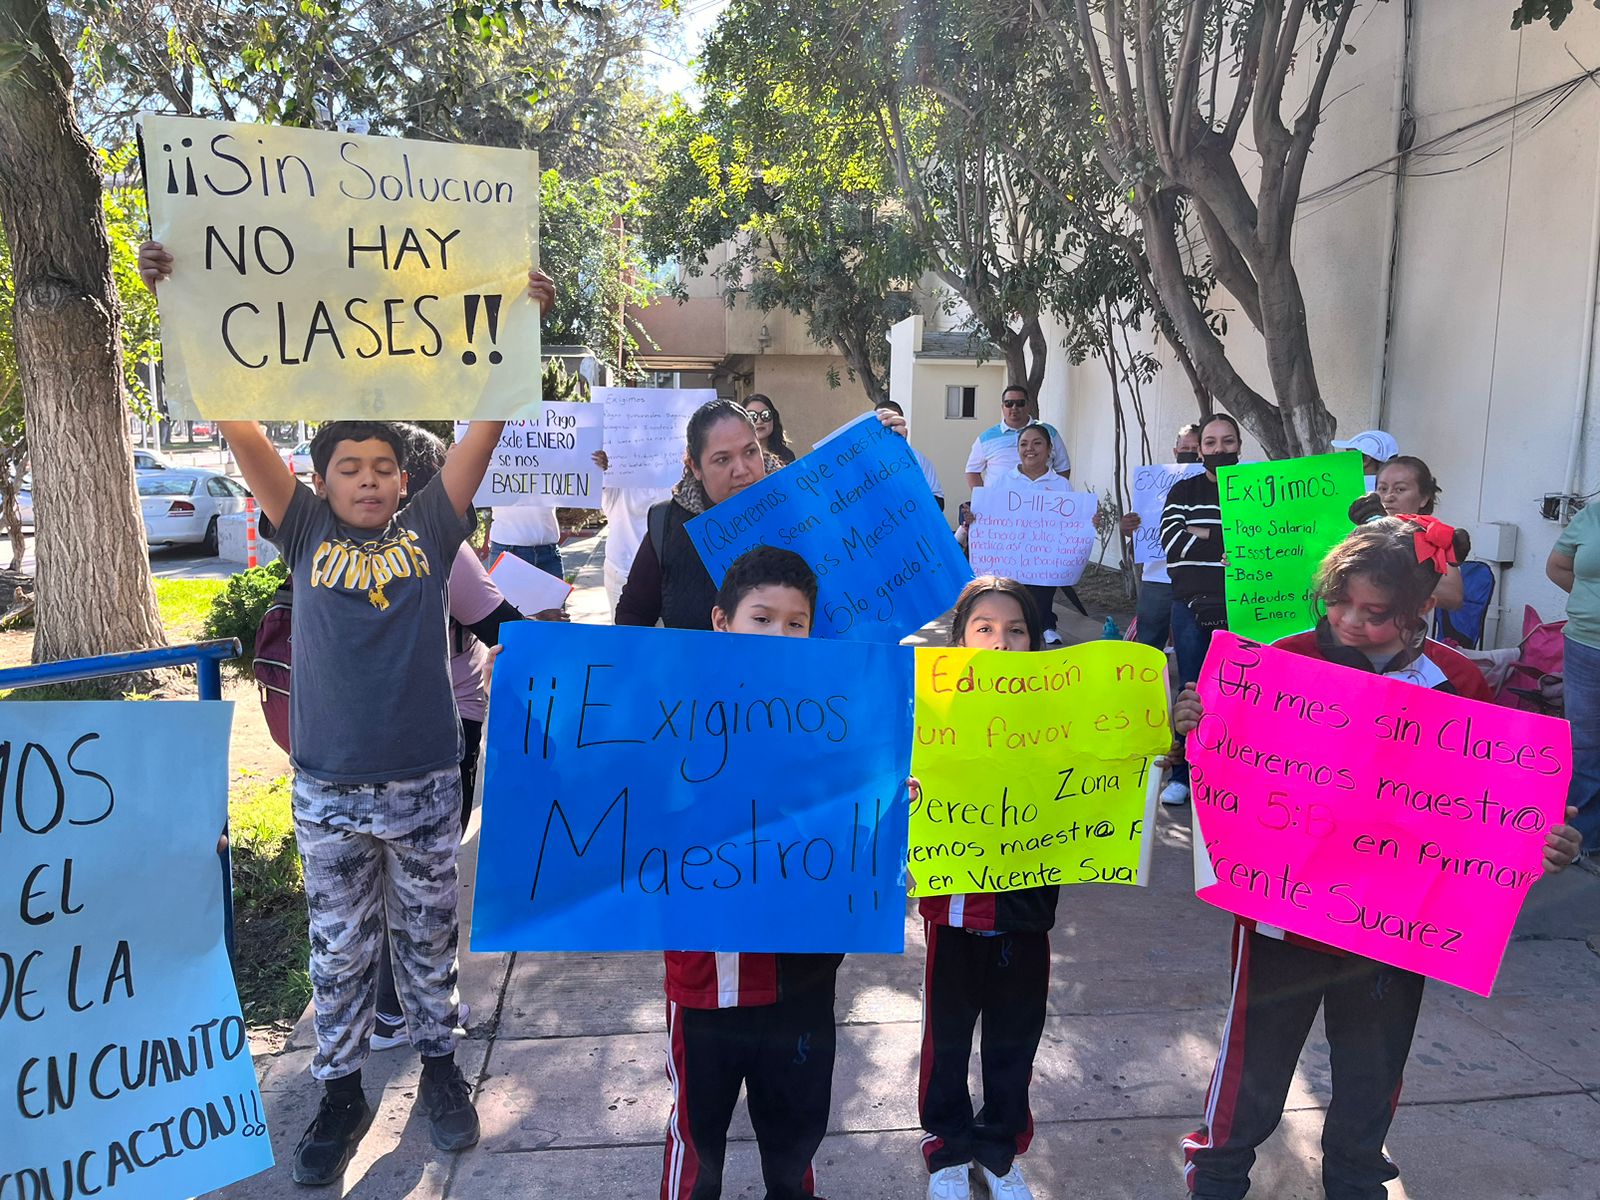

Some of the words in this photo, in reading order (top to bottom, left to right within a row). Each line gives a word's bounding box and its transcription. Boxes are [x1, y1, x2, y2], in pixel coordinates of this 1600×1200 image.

[163, 133, 316, 197] ¡¡Sin
[338, 140, 514, 204] Solucion
[205, 225, 296, 276] NO
[348, 225, 461, 271] HAY
[546, 409, 576, 429] Pago
[526, 431, 576, 450] ENERO
[515, 454, 539, 467] nos
[795, 461, 834, 497] que
[492, 473, 590, 497] BASIFIQUEN
[841, 497, 917, 561] Maestro
[1235, 519, 1262, 537] Pago
[310, 529, 431, 590] COWBOYS
[1240, 590, 1296, 605] Adeudos
[1255, 606, 1296, 622] Enero
[931, 655, 1081, 694] Educación
[1116, 664, 1159, 683] no
[917, 725, 957, 746] un
[986, 715, 1073, 750] favor
[1094, 710, 1130, 732] es
[1274, 689, 1350, 729] mes
[1375, 707, 1421, 746] sin
[1437, 716, 1562, 776] Clases
[1054, 767, 1120, 801] Zona
[1196, 713, 1356, 791] Queremos
[1376, 775, 1546, 834] maestr@
[530, 786, 882, 914] Maestro!!
[1001, 820, 1115, 856] maestr@
[1353, 833, 1399, 860] en
[19, 857, 85, 926] EL
[928, 871, 954, 891] en
[967, 861, 1062, 891] Vicente
[1326, 883, 1464, 954] Suarez
[66, 939, 135, 1013] LA
[17, 1051, 77, 1119] EN
[89, 1015, 247, 1101] CUANTO
